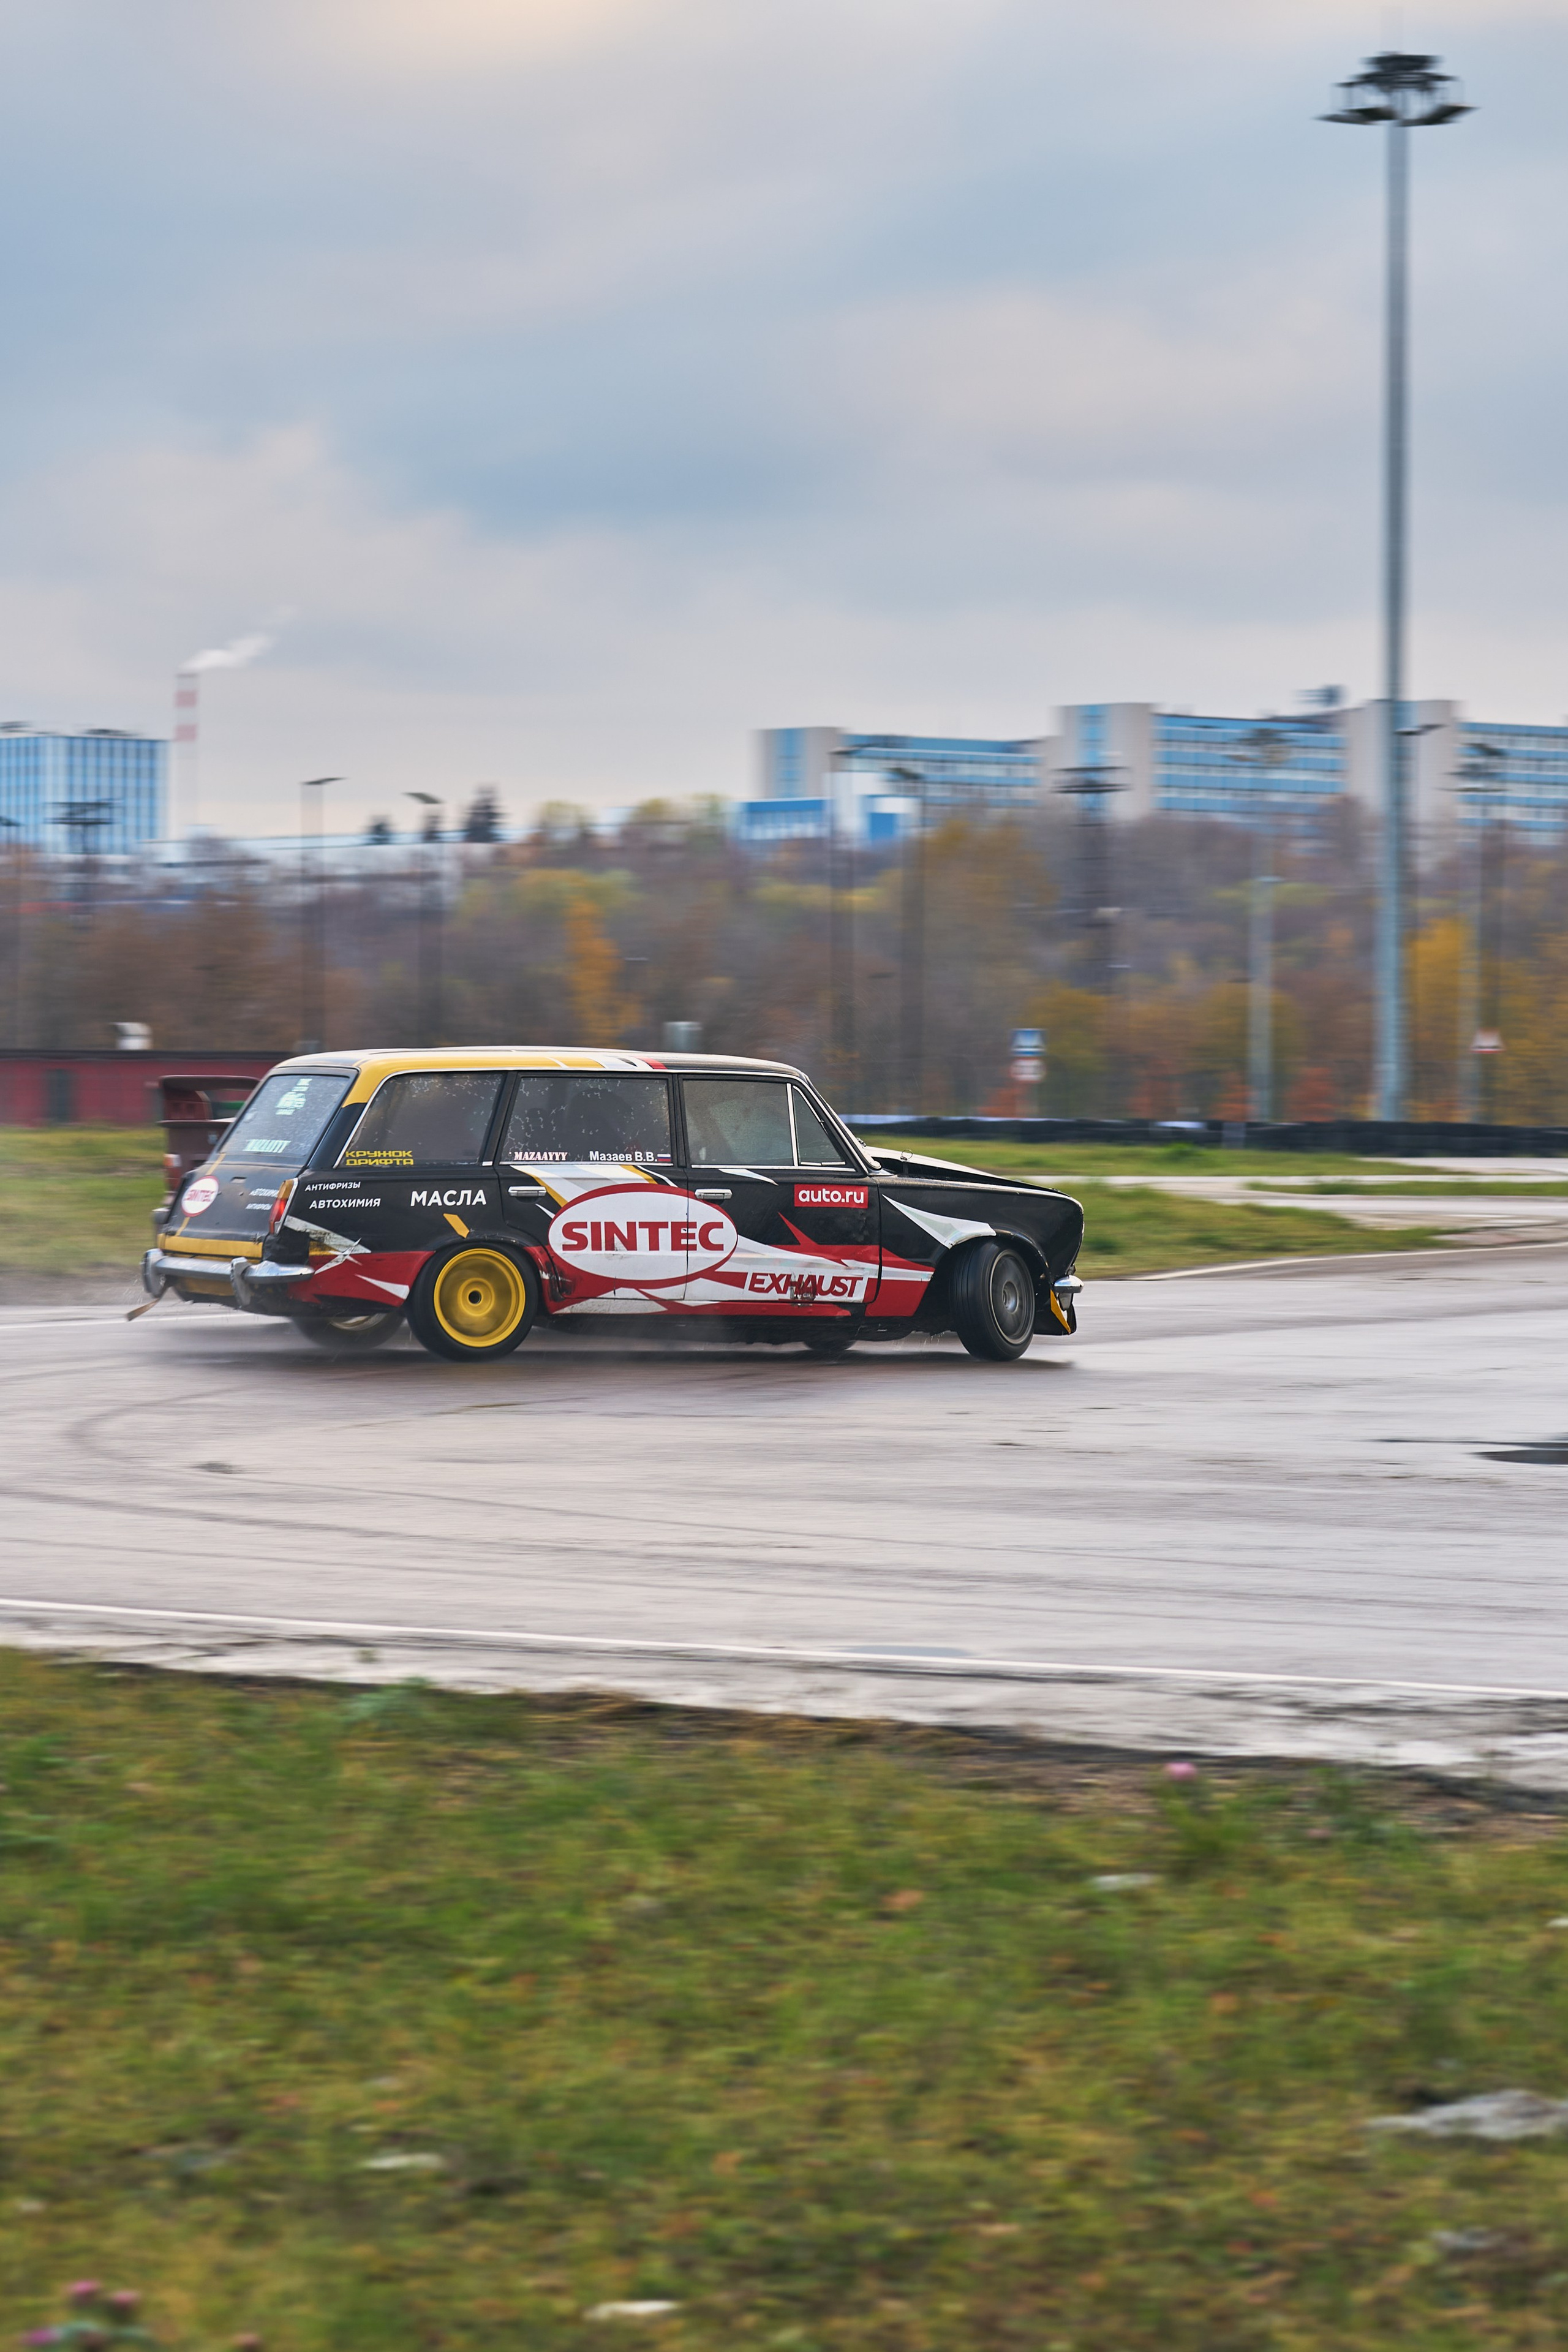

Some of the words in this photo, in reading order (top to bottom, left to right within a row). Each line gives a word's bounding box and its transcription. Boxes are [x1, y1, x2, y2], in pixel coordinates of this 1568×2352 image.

[513, 1152, 568, 1161] MAZAAYYY
[589, 1151, 632, 1161] Мазаев
[635, 1152, 658, 1161] В.В.
[304, 1182, 361, 1192] АНТИФРИЗЫ
[410, 1189, 487, 1207] МАСЛА
[798, 1188, 864, 1204] auto.ru
[309, 1198, 381, 1210] АВТОХИМИЯ
[562, 1221, 724, 1251] SINTEC
[748, 1272, 864, 1297] EXHAUST
